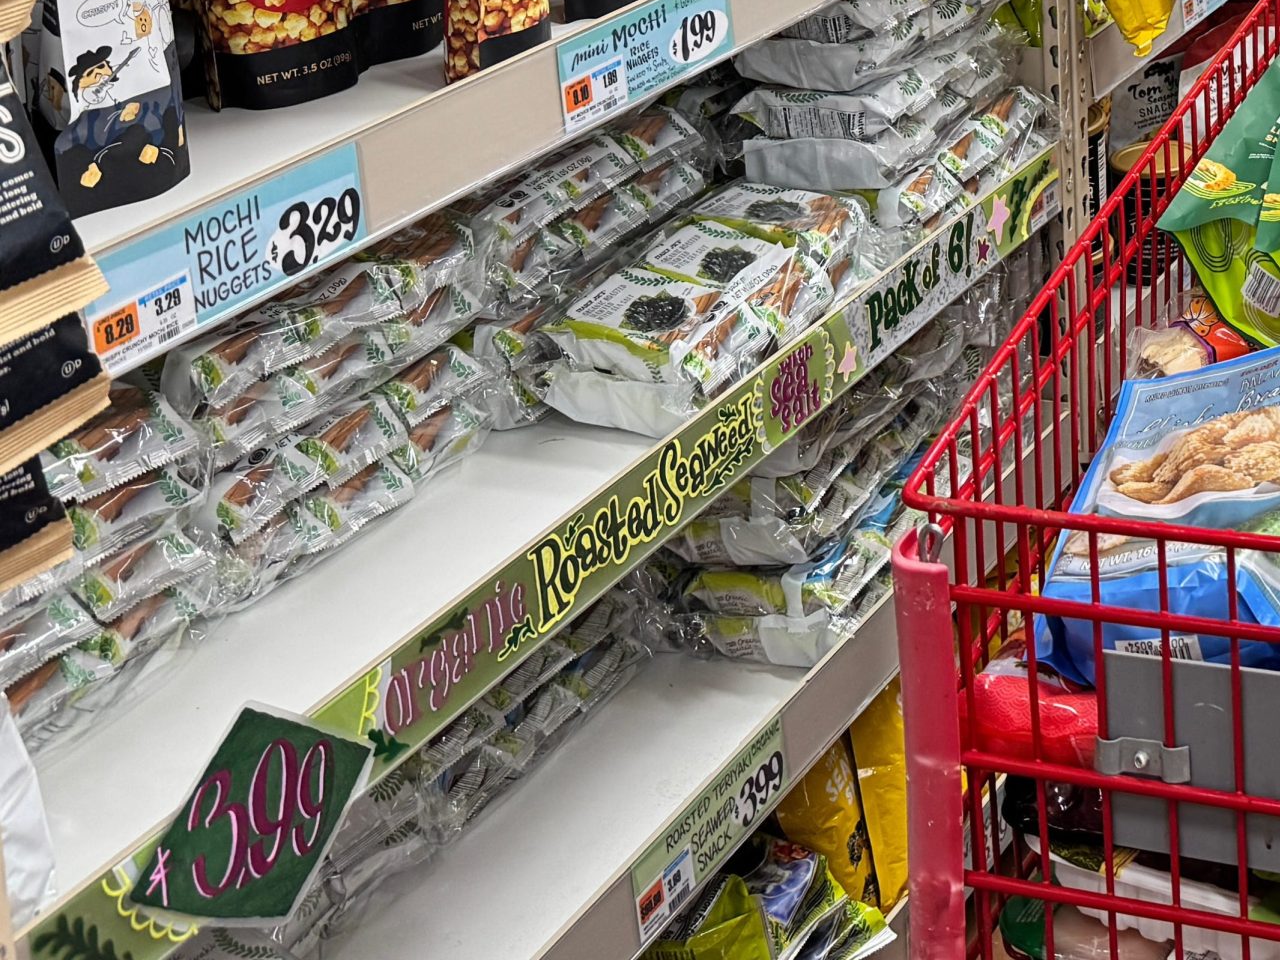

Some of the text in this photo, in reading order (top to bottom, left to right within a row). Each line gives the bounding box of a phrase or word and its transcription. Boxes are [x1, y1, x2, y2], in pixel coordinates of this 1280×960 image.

[571, 4, 667, 72] mini MOCHI
[673, 11, 716, 61] $1.99
[257, 72, 279, 86] NET
[281, 68, 301, 81] WT.
[303, 63, 318, 75] 3.5
[319, 59, 333, 70] OZ
[2, 170, 35, 188] comes
[3, 184, 28, 200] long
[184, 195, 261, 255] MOCHI
[271, 187, 360, 276] $3.29
[922, 243, 941, 290] of
[948, 212, 973, 279] 6!
[197, 227, 257, 285] RICE
[155, 288, 181, 317] 3.29
[193, 261, 272, 313] NUGGETS
[530, 475, 659, 635] Roasted
[659, 392, 756, 522] Seaweed
[665, 719, 780, 854] ROASTED TERIYAKI ORGANIC
[734, 751, 783, 828] $3.99
[147, 738, 334, 907] $3.99
[690, 797, 735, 856] SEAWEED
[697, 826, 732, 873] SNACK
